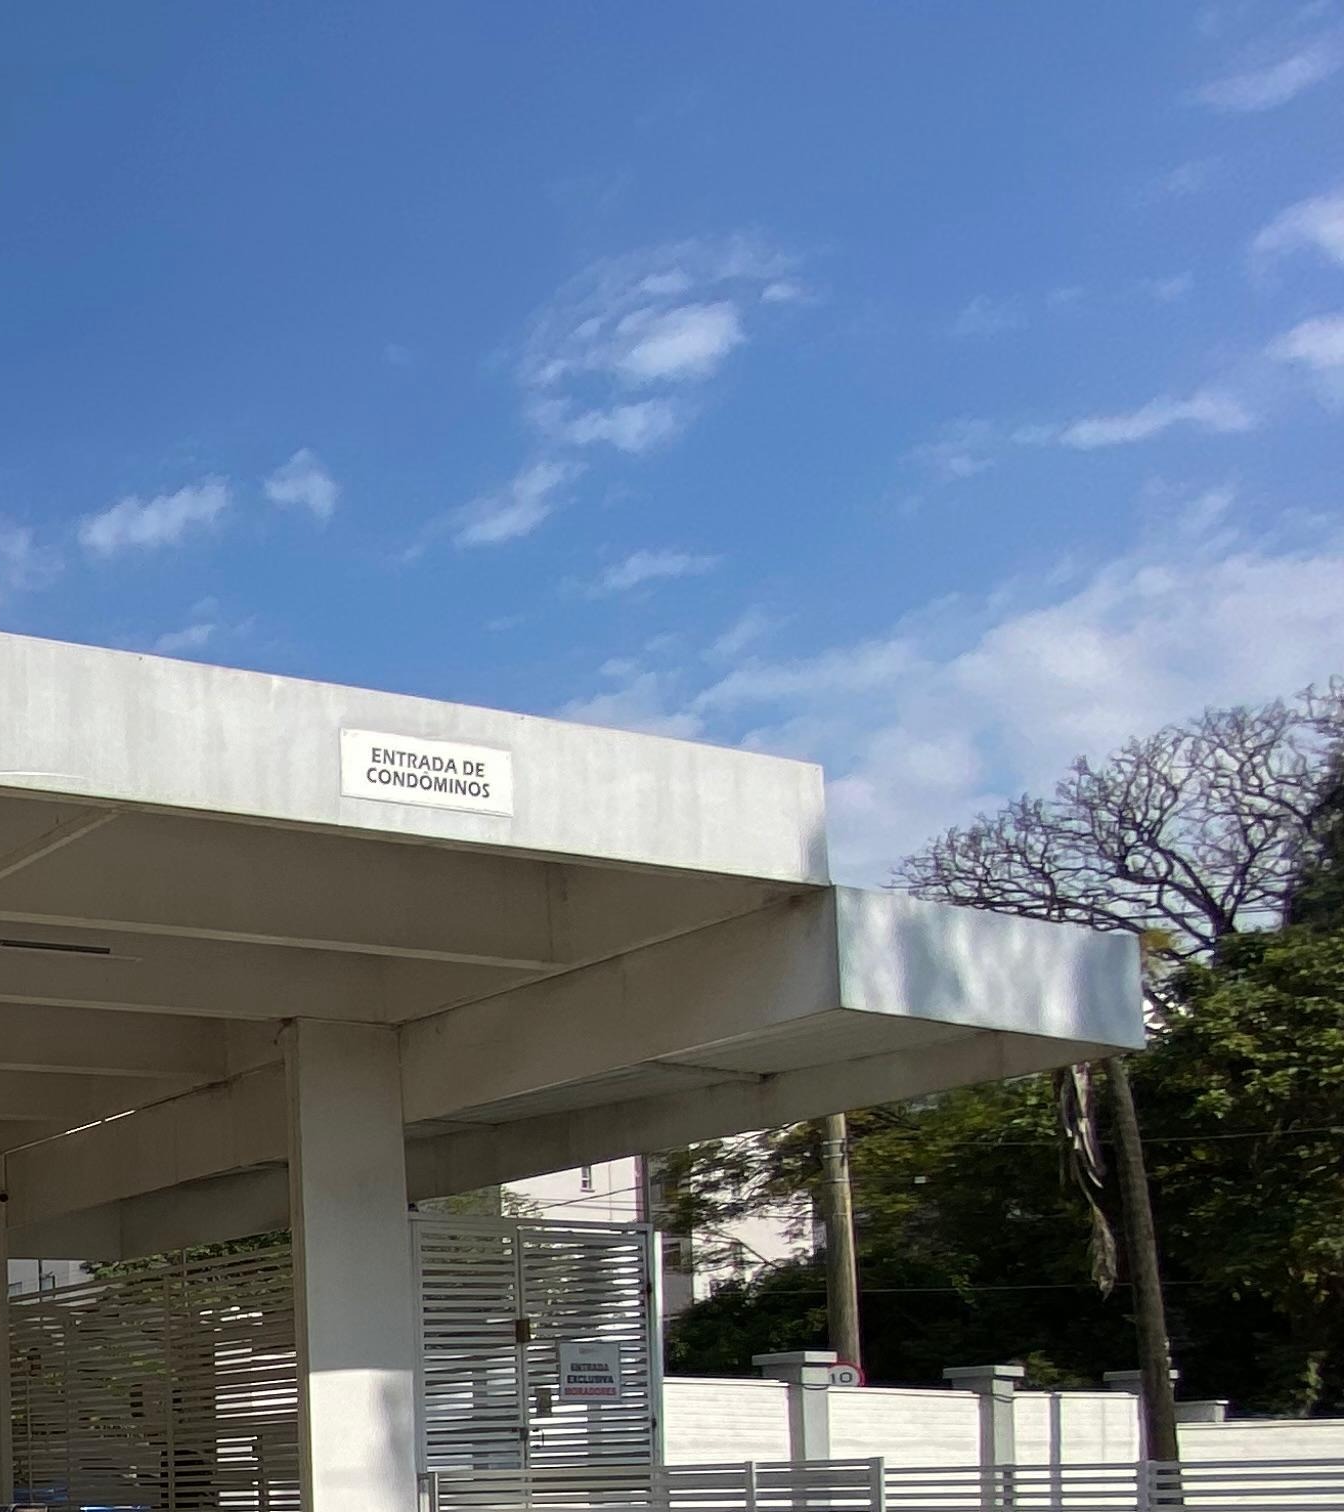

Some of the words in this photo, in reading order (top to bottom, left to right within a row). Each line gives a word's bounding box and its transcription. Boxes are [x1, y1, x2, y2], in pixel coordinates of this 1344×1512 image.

[371, 747, 458, 775] ENTRADA
[463, 760, 485, 778] DE
[366, 767, 490, 798] CONDÔMINOS
[831, 1371, 853, 1384] 10
